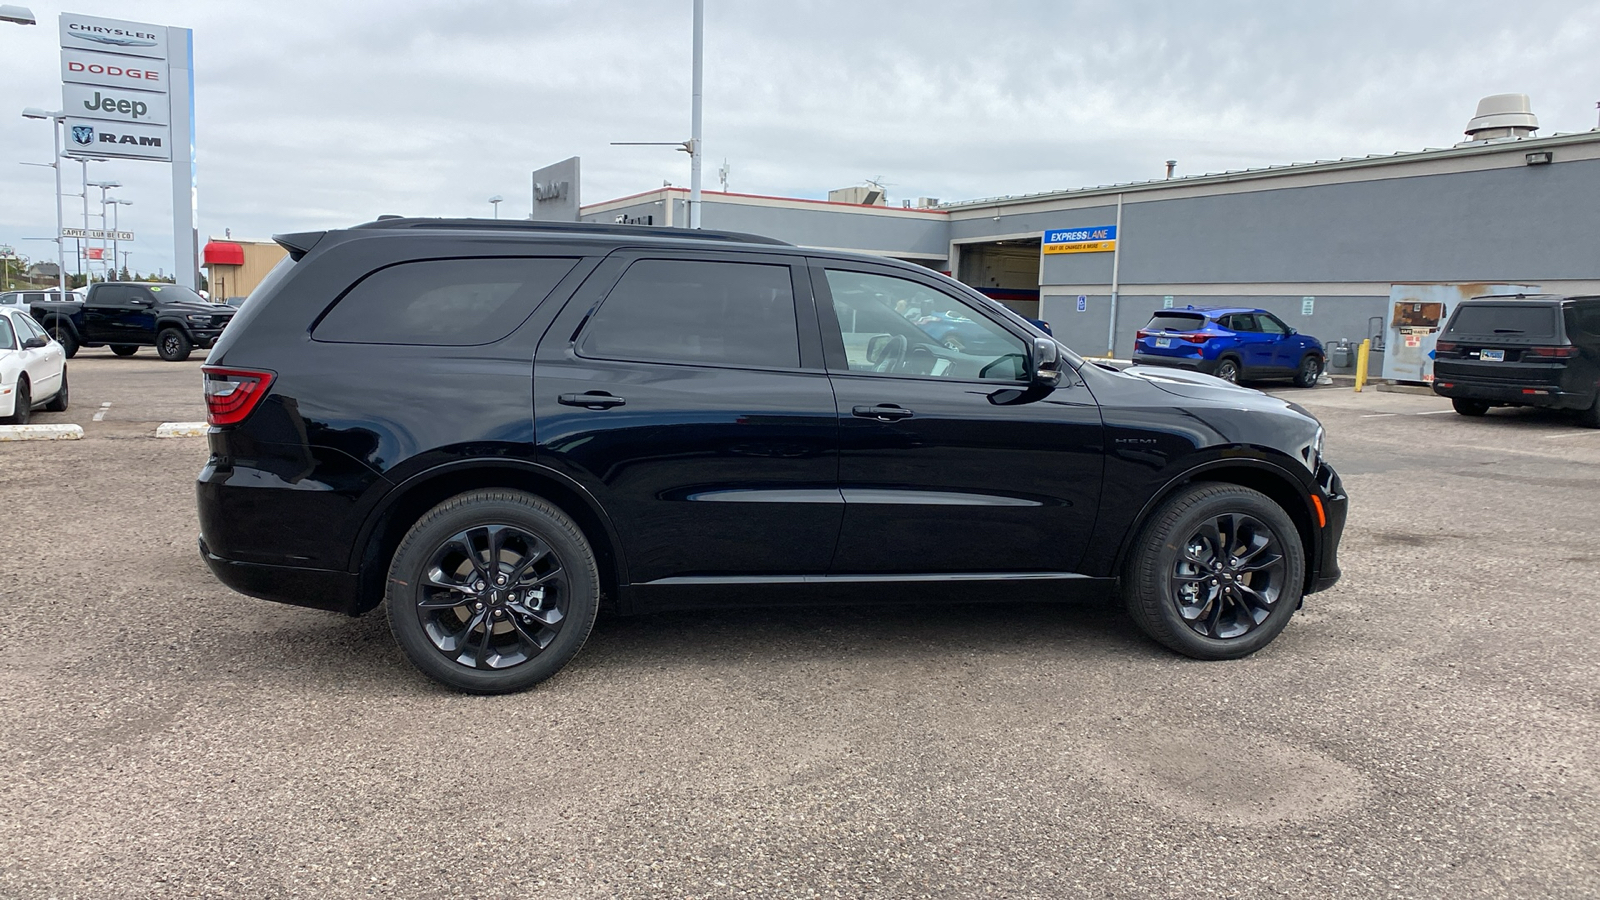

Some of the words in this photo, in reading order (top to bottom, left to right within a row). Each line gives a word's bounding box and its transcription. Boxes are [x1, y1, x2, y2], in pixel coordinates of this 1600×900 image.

[69, 23, 156, 40] CHRYSLER
[68, 62, 159, 81] DODGE
[84, 92, 148, 118] Jeep
[99, 132, 162, 147] RAM
